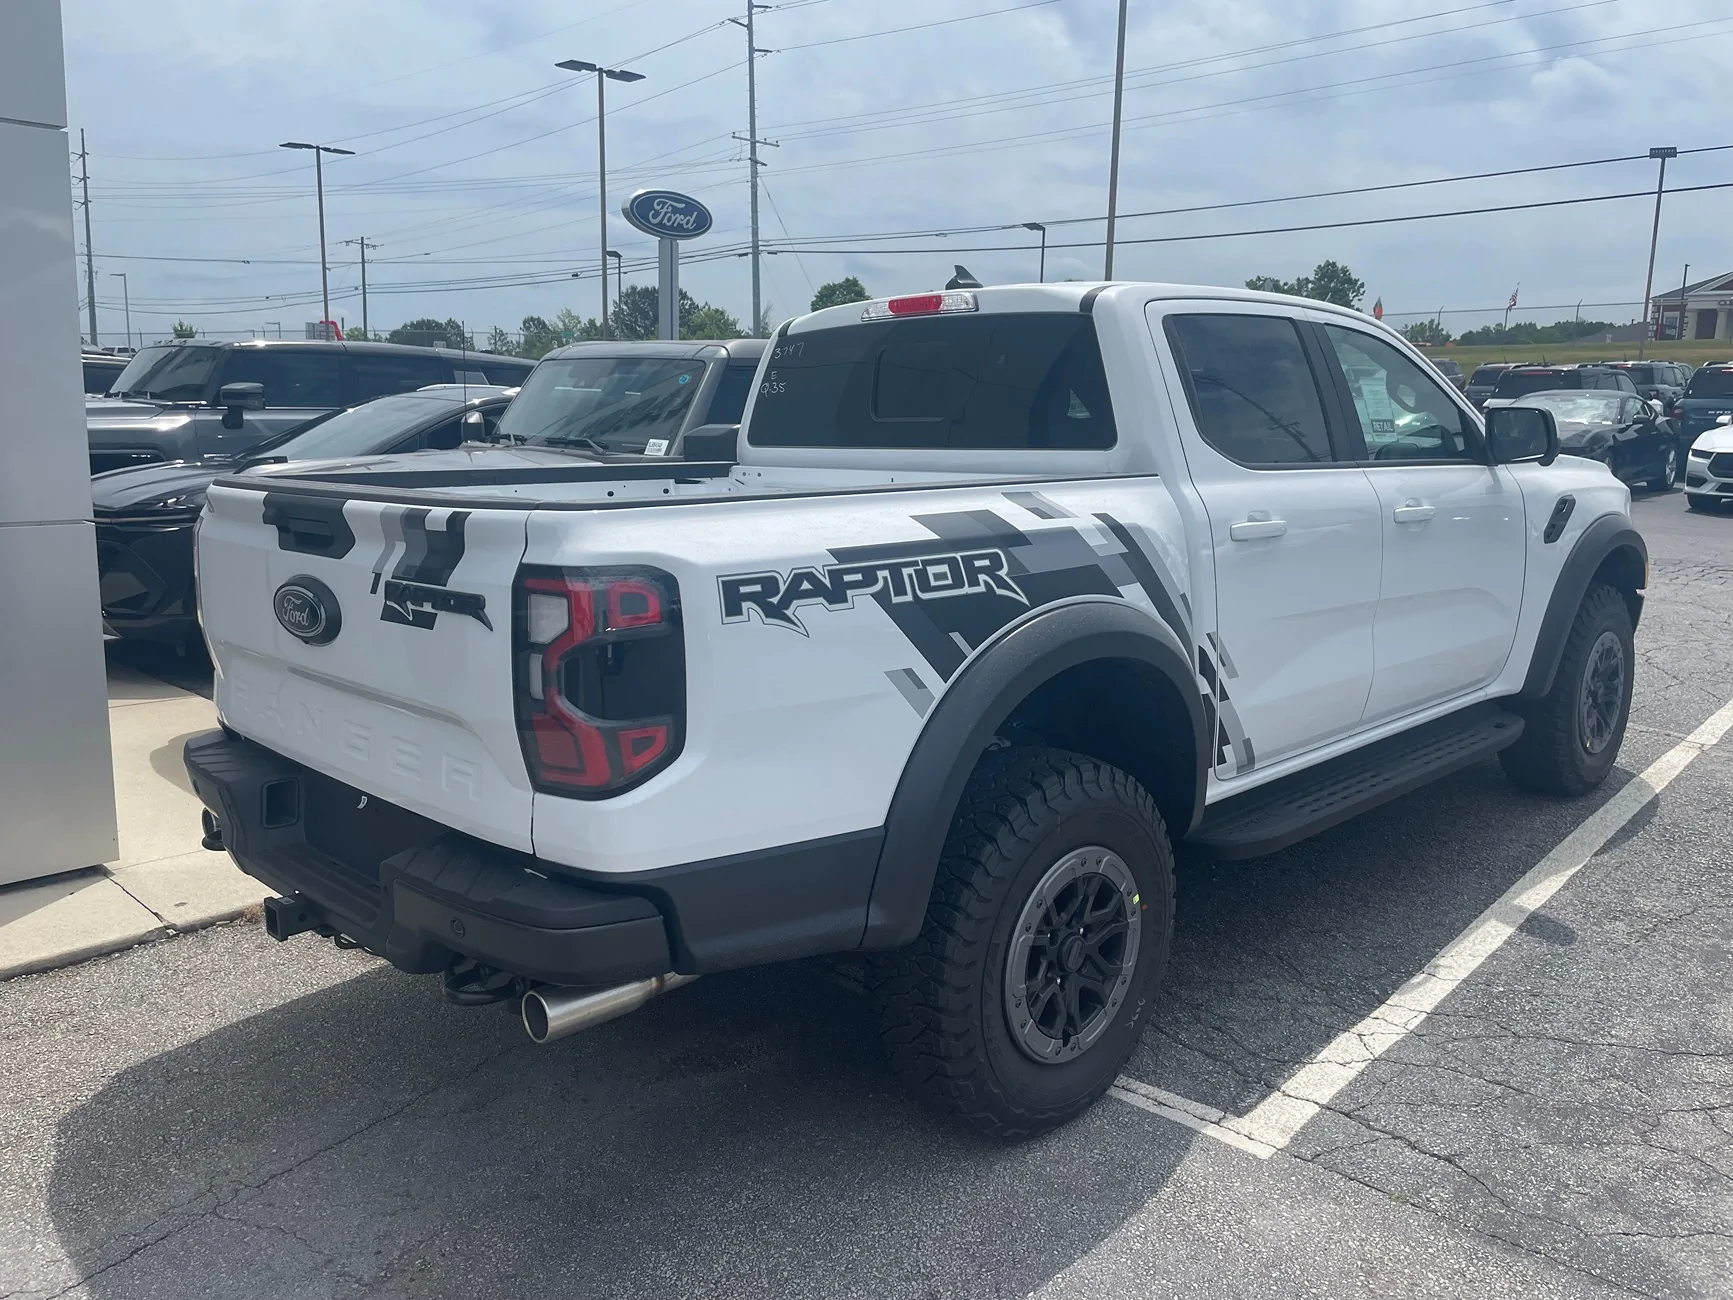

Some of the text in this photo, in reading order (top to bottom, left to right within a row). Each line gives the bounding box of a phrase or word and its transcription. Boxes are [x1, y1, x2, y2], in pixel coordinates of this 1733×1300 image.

[649, 198, 698, 230] Ford
[1373, 421, 1394, 432] RETAIL
[716, 548, 1031, 638] RAPTOR
[283, 596, 310, 626] Ford
[230, 677, 483, 801] RANGER
